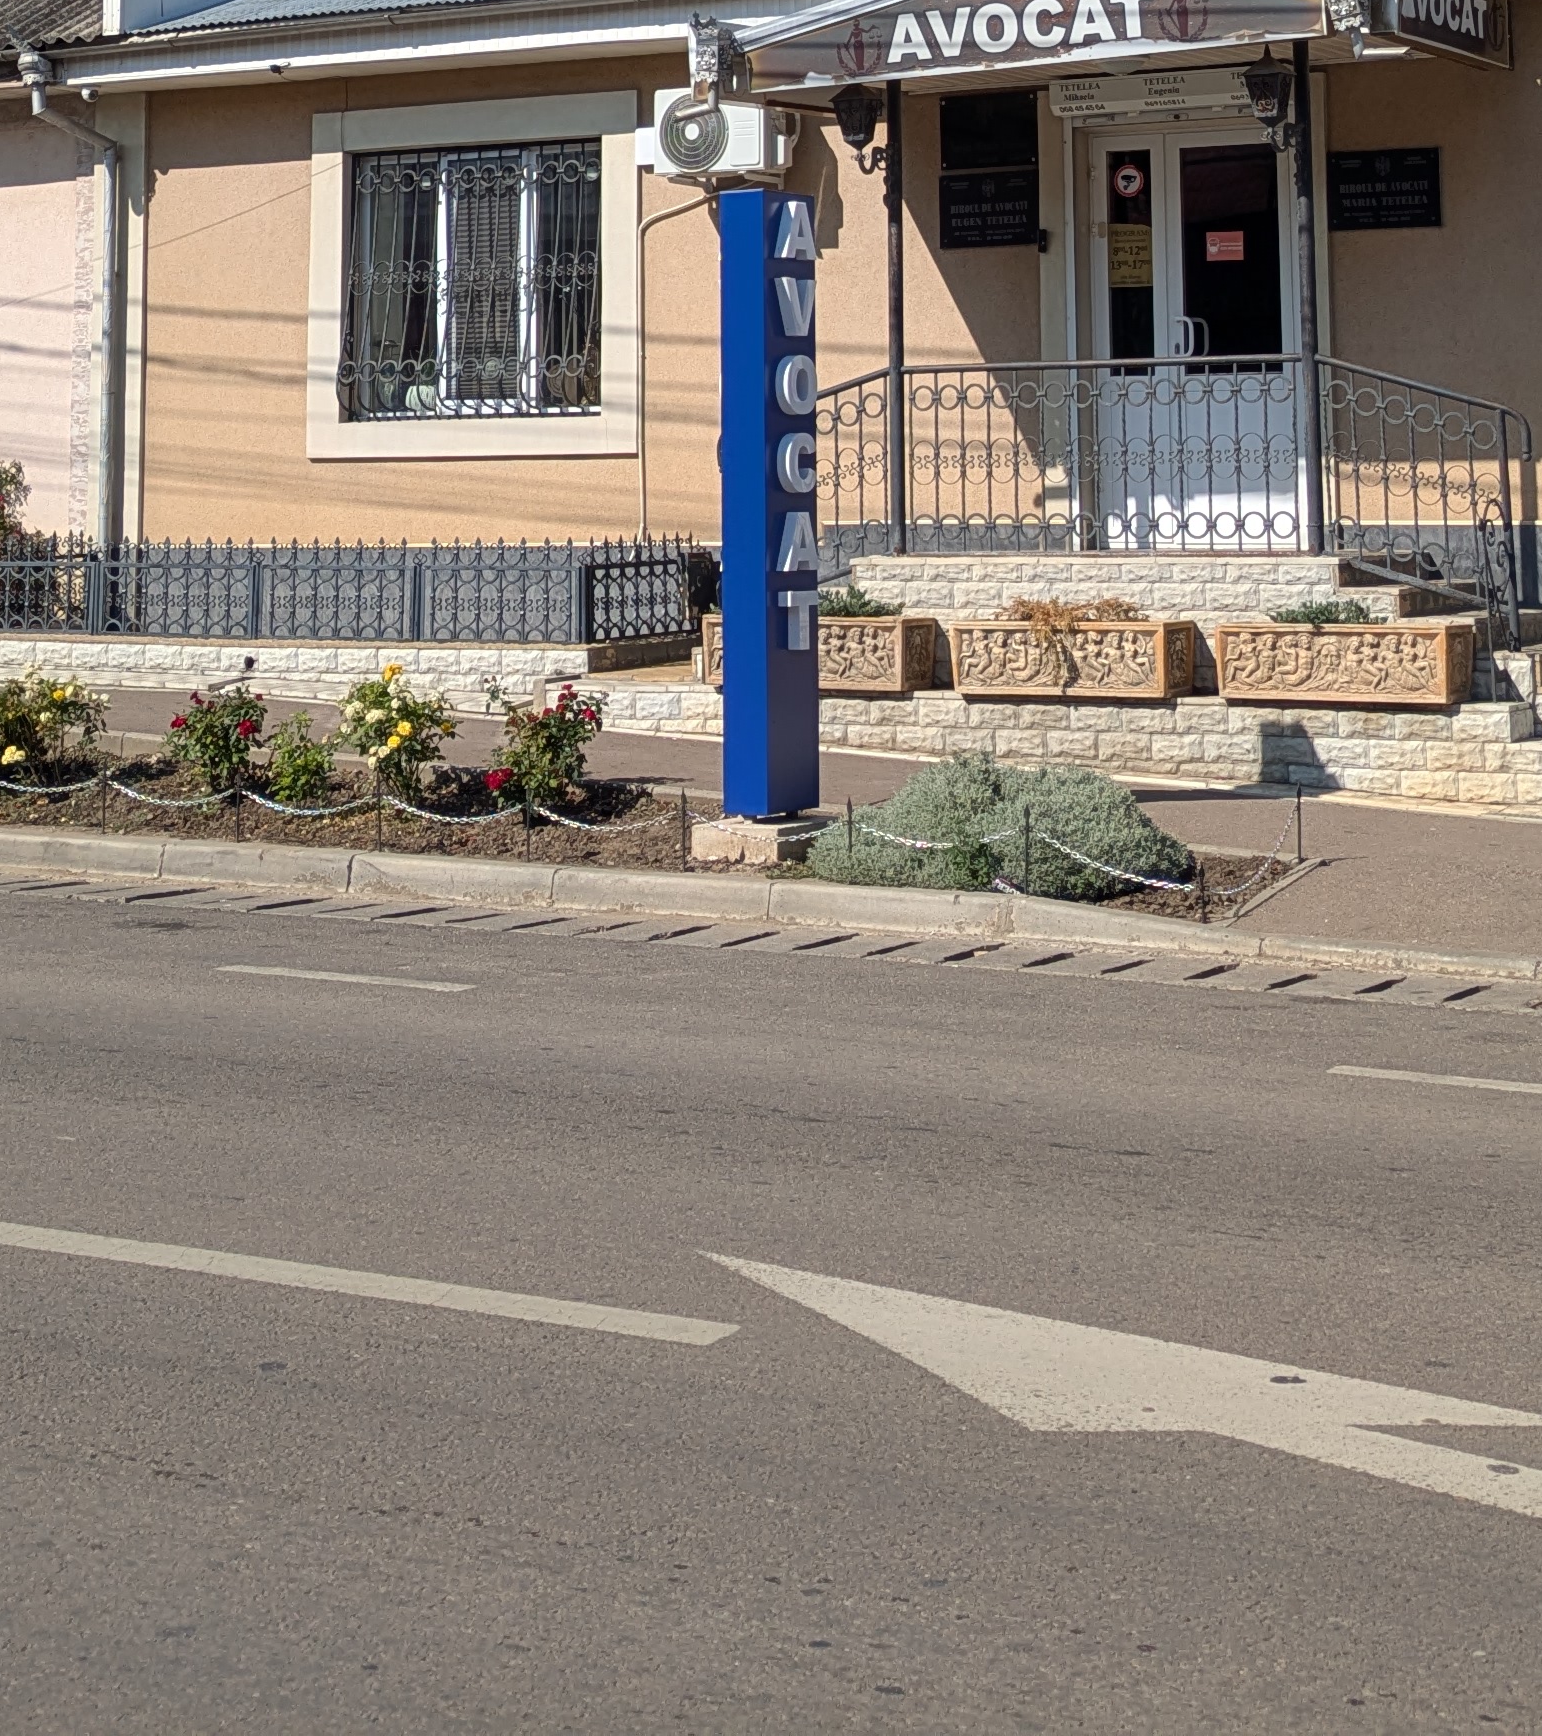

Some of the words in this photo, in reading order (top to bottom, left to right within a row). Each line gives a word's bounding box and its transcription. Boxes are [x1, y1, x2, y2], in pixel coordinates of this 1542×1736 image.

[1143, 76, 1186, 86] TETELEA
[1059, 82, 1101, 92] TETELEA
[1375, 182, 1387, 192] DE
[1381, 194, 1428, 206] TETELEA
[981, 202, 992, 213] DE
[951, 217, 982, 227] EUGEN
[986, 214, 1028, 225] TETELEA
[774, 201, 819, 651] AVOCAT
